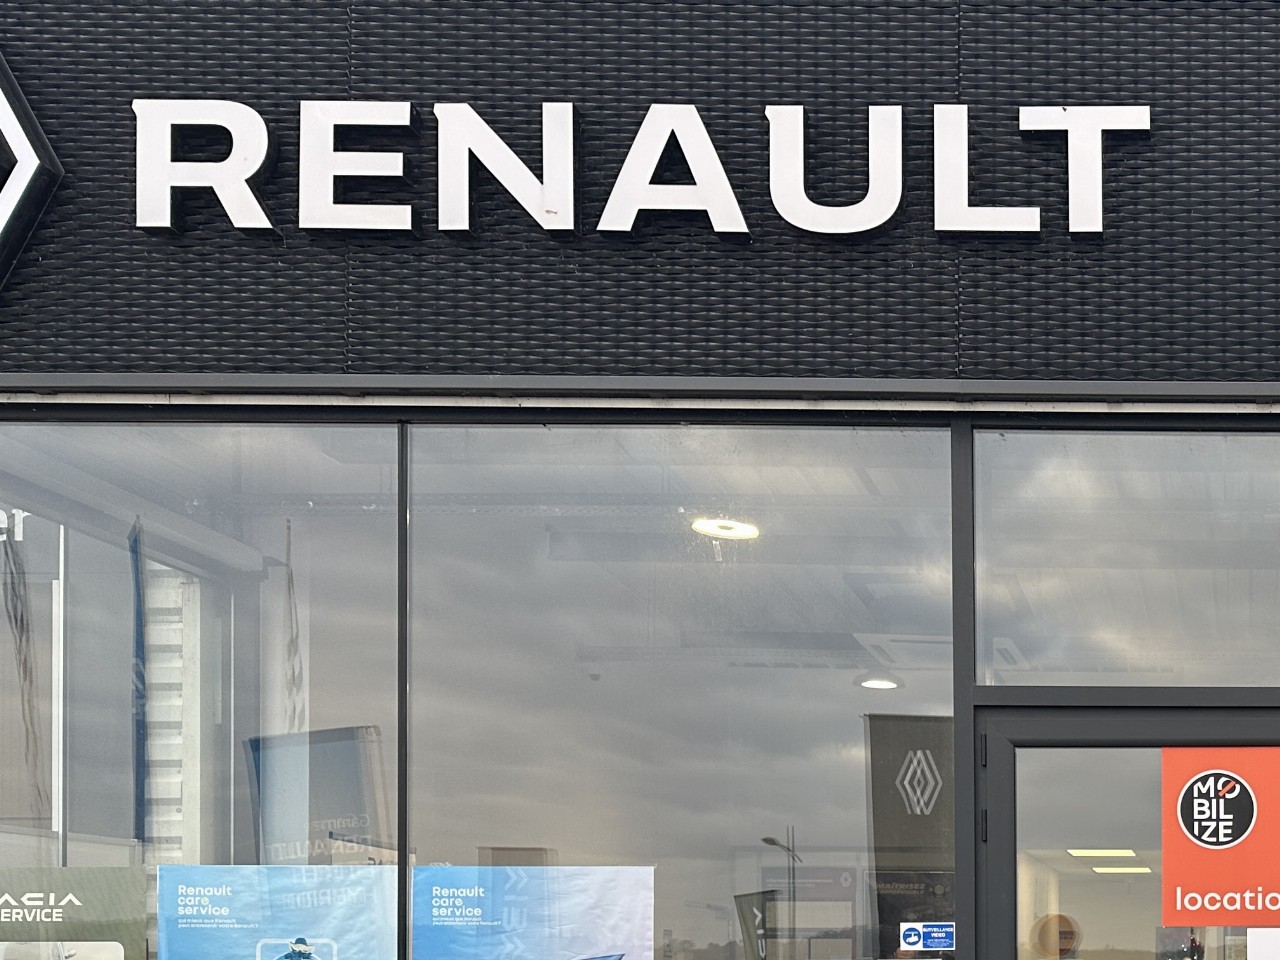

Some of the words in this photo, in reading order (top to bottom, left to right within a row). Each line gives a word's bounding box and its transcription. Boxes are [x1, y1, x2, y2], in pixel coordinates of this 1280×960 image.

[131, 98, 1151, 234] RENAULT
[177, 884, 233, 896] Renault
[432, 886, 485, 897] Renault
[177, 896, 210, 906] care
[431, 897, 463, 907] care
[0, 908, 63, 922] ERVICE
[177, 904, 230, 916] service
[431, 905, 482, 917] service
